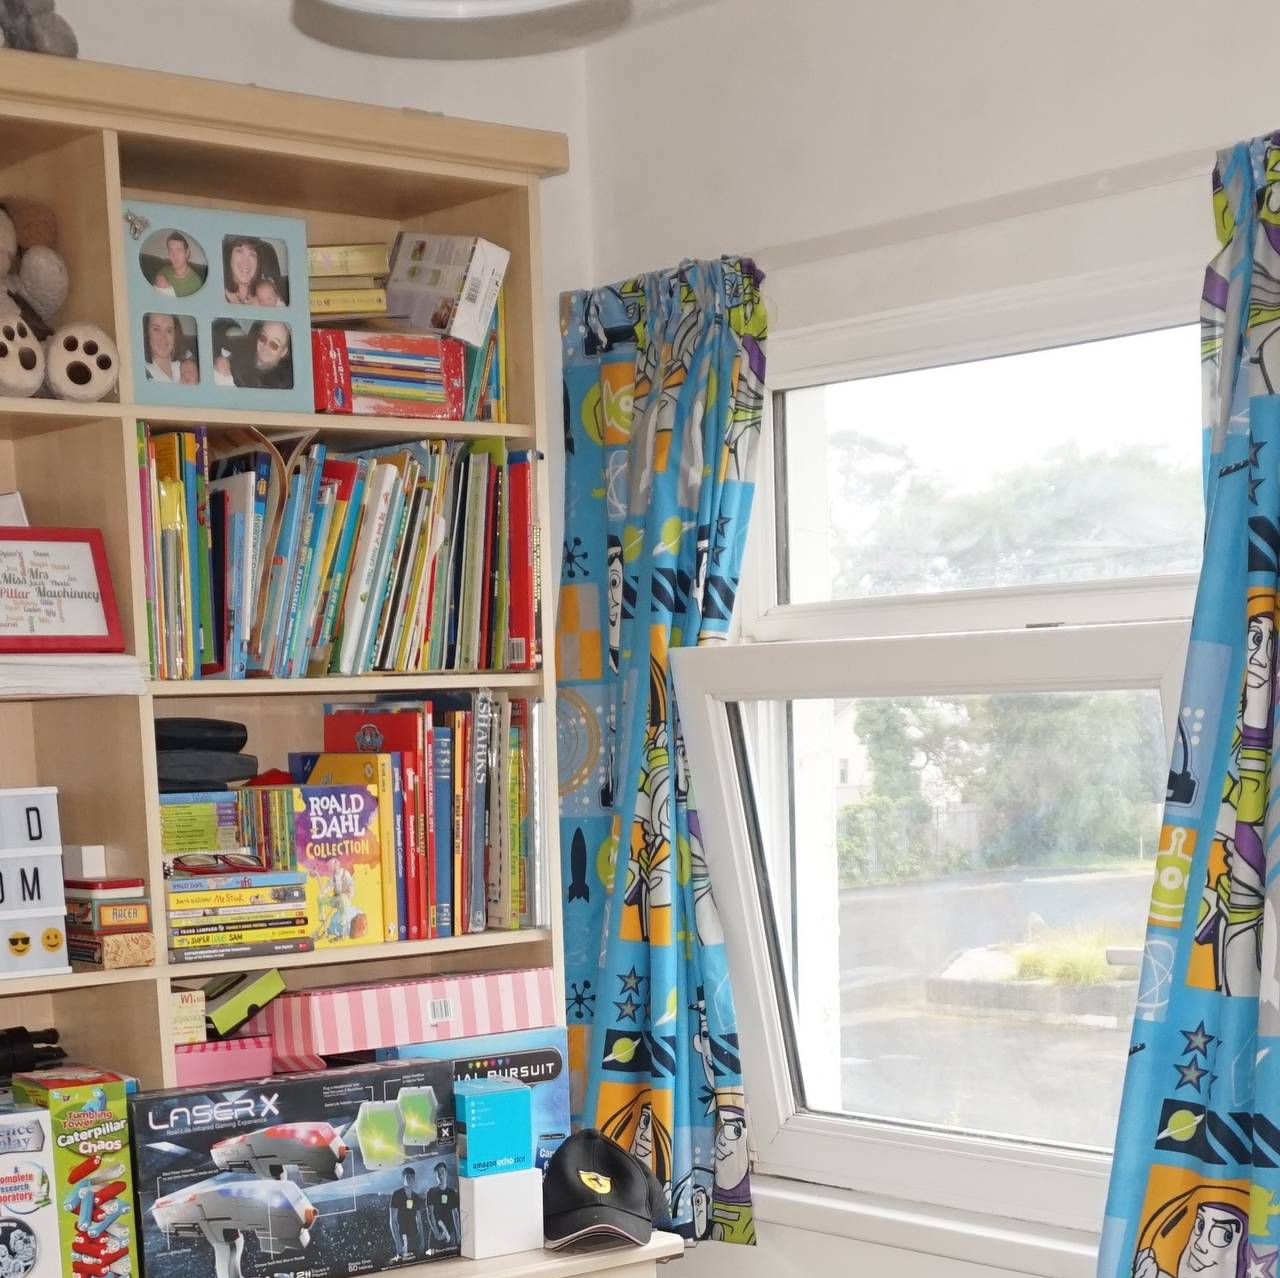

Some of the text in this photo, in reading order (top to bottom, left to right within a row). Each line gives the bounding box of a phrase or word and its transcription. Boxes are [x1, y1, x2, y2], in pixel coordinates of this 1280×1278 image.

[1, 572, 27, 585] Miss
[29, 568, 49, 580] Mrs
[476, 701, 491, 785] SHARKS
[309, 794, 365, 816] ROALD
[311, 815, 366, 839] DAHL
[306, 839, 370, 859] COLLECTION
[112, 908, 138, 920] RACER
[191, 933, 243, 945] SUPER SAM
[487, 1062, 555, 1079] PURSUIT
[67, 1110, 112, 1120] Tumbling
[148, 1092, 280, 1131] LASER X
[63, 1120, 93, 1128] Tower
[215, 1121, 236, 1130] Gaming
[57, 1119, 127, 1147] Caterpillar
[79, 1139, 122, 1154] Chaos
[472, 1155, 526, 1169] amazon echo dot
[13, 1166, 19, 1174] A
